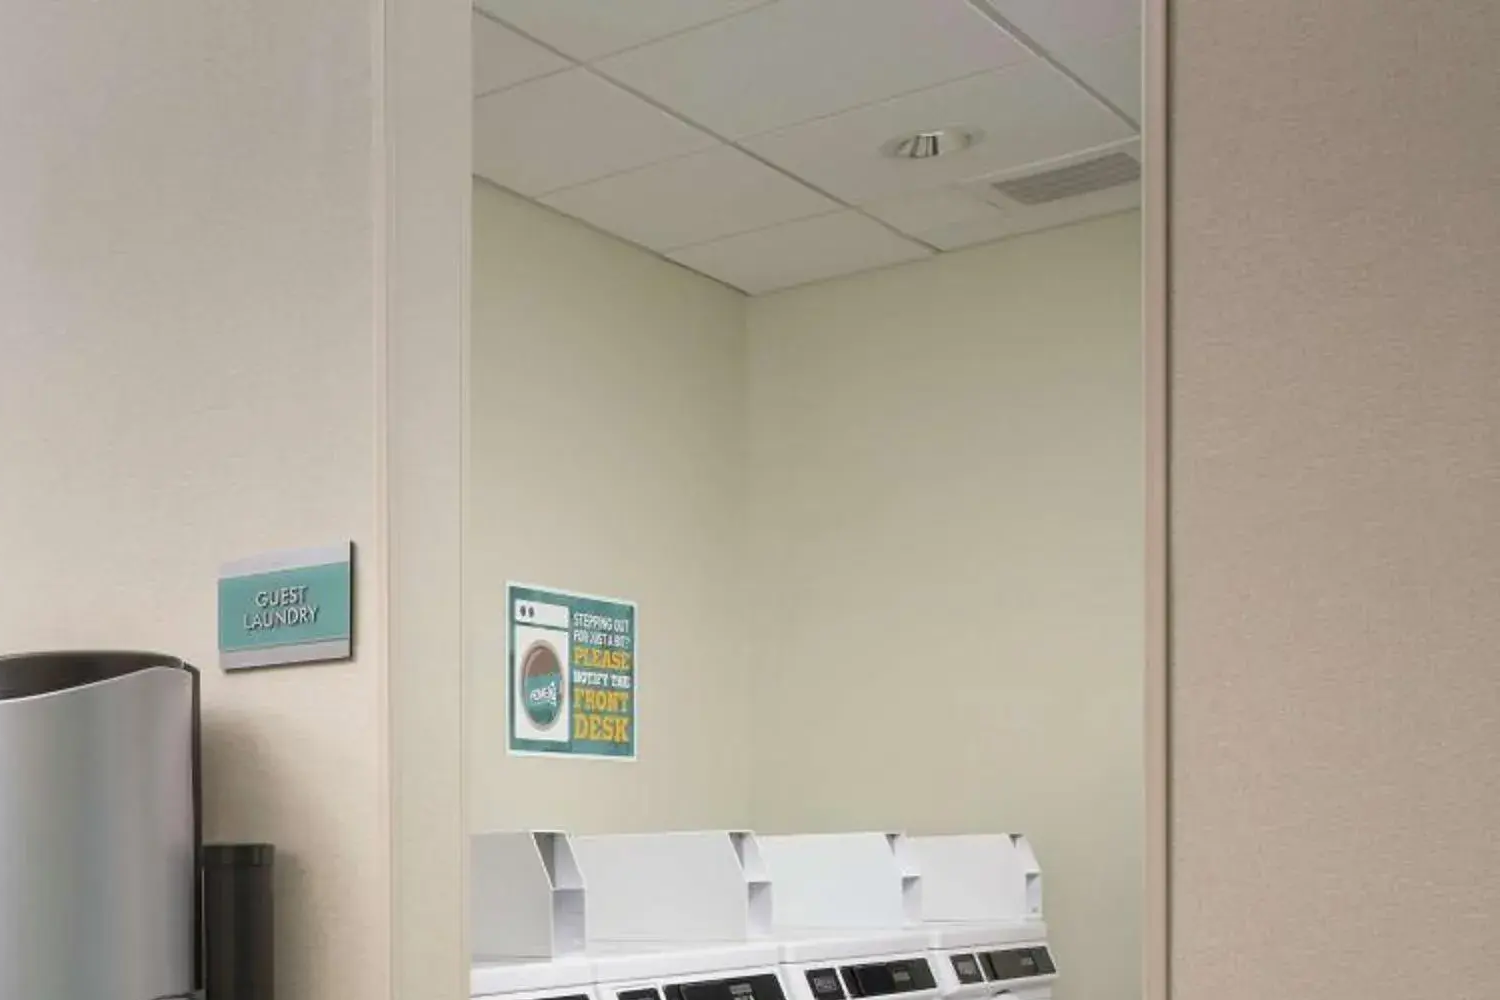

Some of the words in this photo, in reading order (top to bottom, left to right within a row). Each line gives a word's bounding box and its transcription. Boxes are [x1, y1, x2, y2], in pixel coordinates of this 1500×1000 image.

[255, 585, 308, 607] GUEST
[243, 604, 319, 629] LAUNDRY
[573, 611, 613, 631] STEPPING
[613, 618, 629, 633] OUT
[573, 646, 630, 669] PLEASE
[573, 670, 608, 686] NOTIFY
[573, 688, 629, 712] FRONT
[573, 713, 629, 742] DESK
